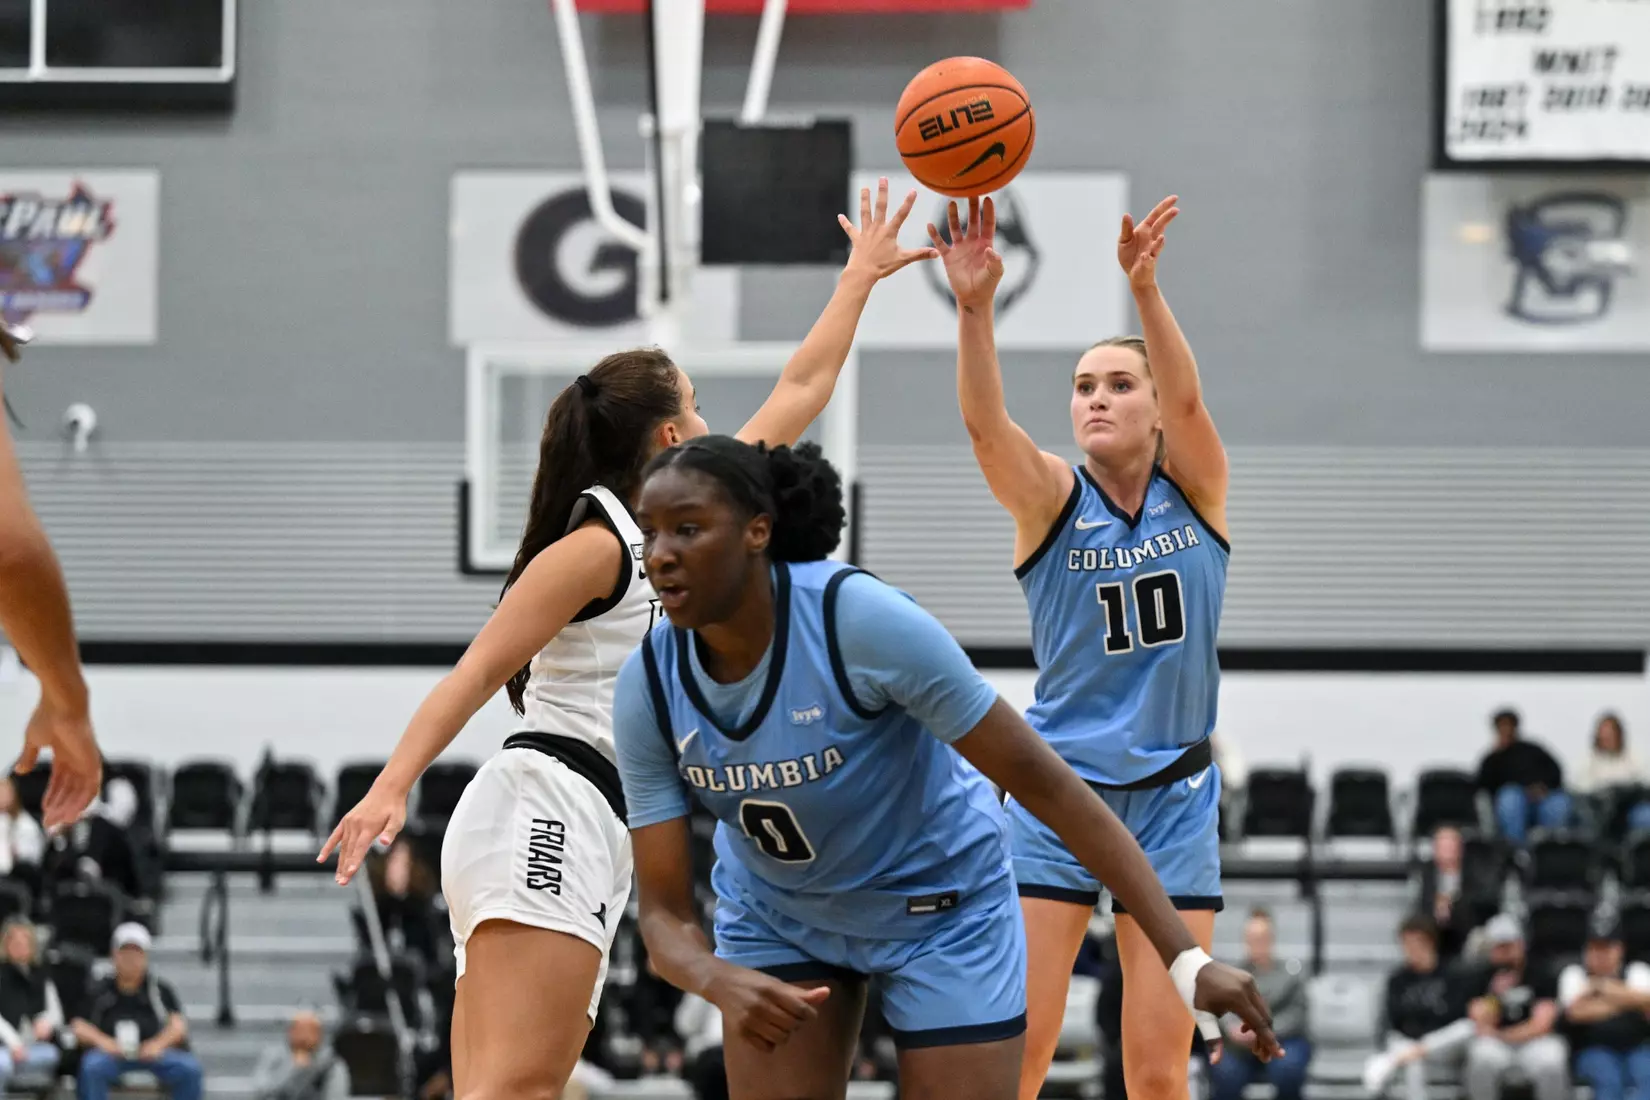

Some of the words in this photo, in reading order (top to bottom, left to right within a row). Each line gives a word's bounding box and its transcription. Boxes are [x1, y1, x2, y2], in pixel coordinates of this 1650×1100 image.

[919, 100, 994, 142] ELITE
[1067, 524, 1200, 571] COLUMBIA
[1096, 569, 1186, 655] 10
[683, 745, 843, 791] OLUMBIA
[527, 818, 565, 895] FRIARS
[739, 799, 816, 864] 0
